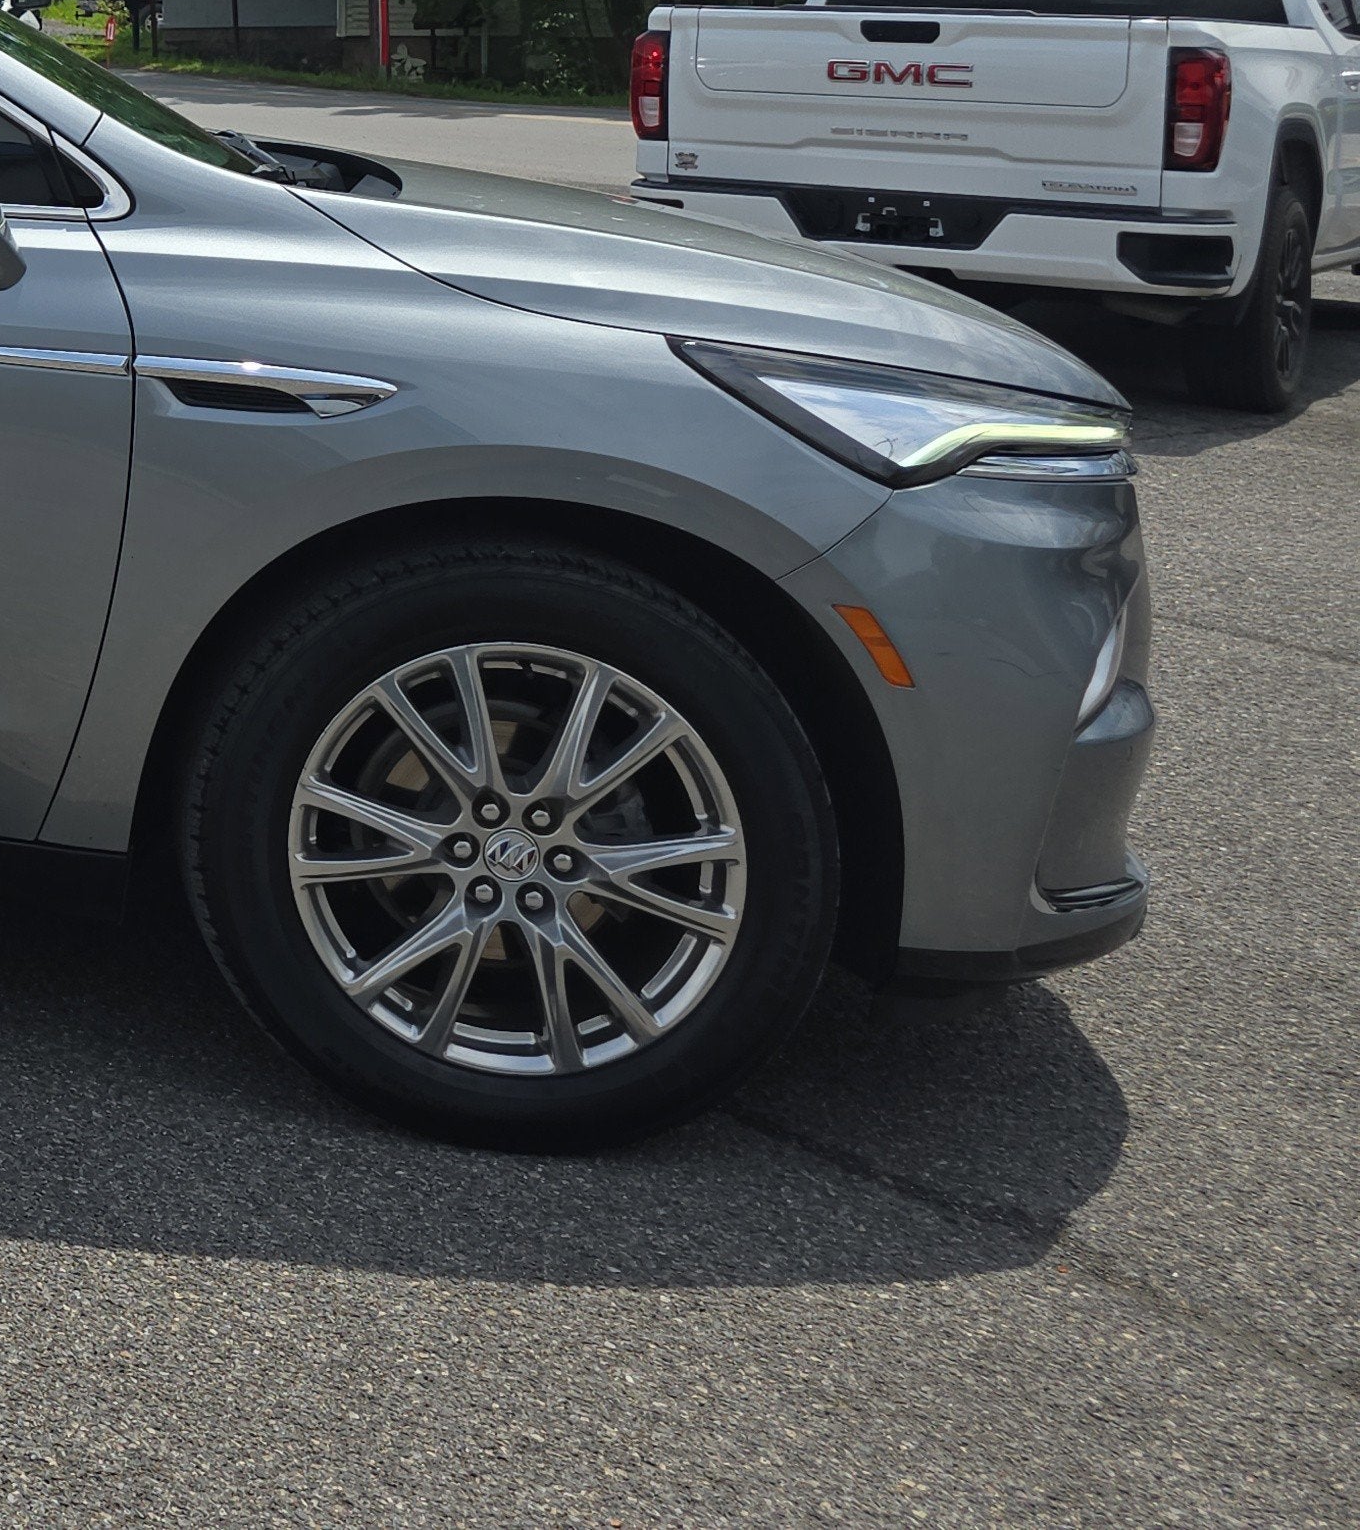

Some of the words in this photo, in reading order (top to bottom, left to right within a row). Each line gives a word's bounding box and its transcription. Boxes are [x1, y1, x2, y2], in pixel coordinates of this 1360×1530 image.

[827, 58, 974, 88] GMC
[831, 127, 969, 141] SIERRA
[1049, 181, 1130, 192] ELEVATION
